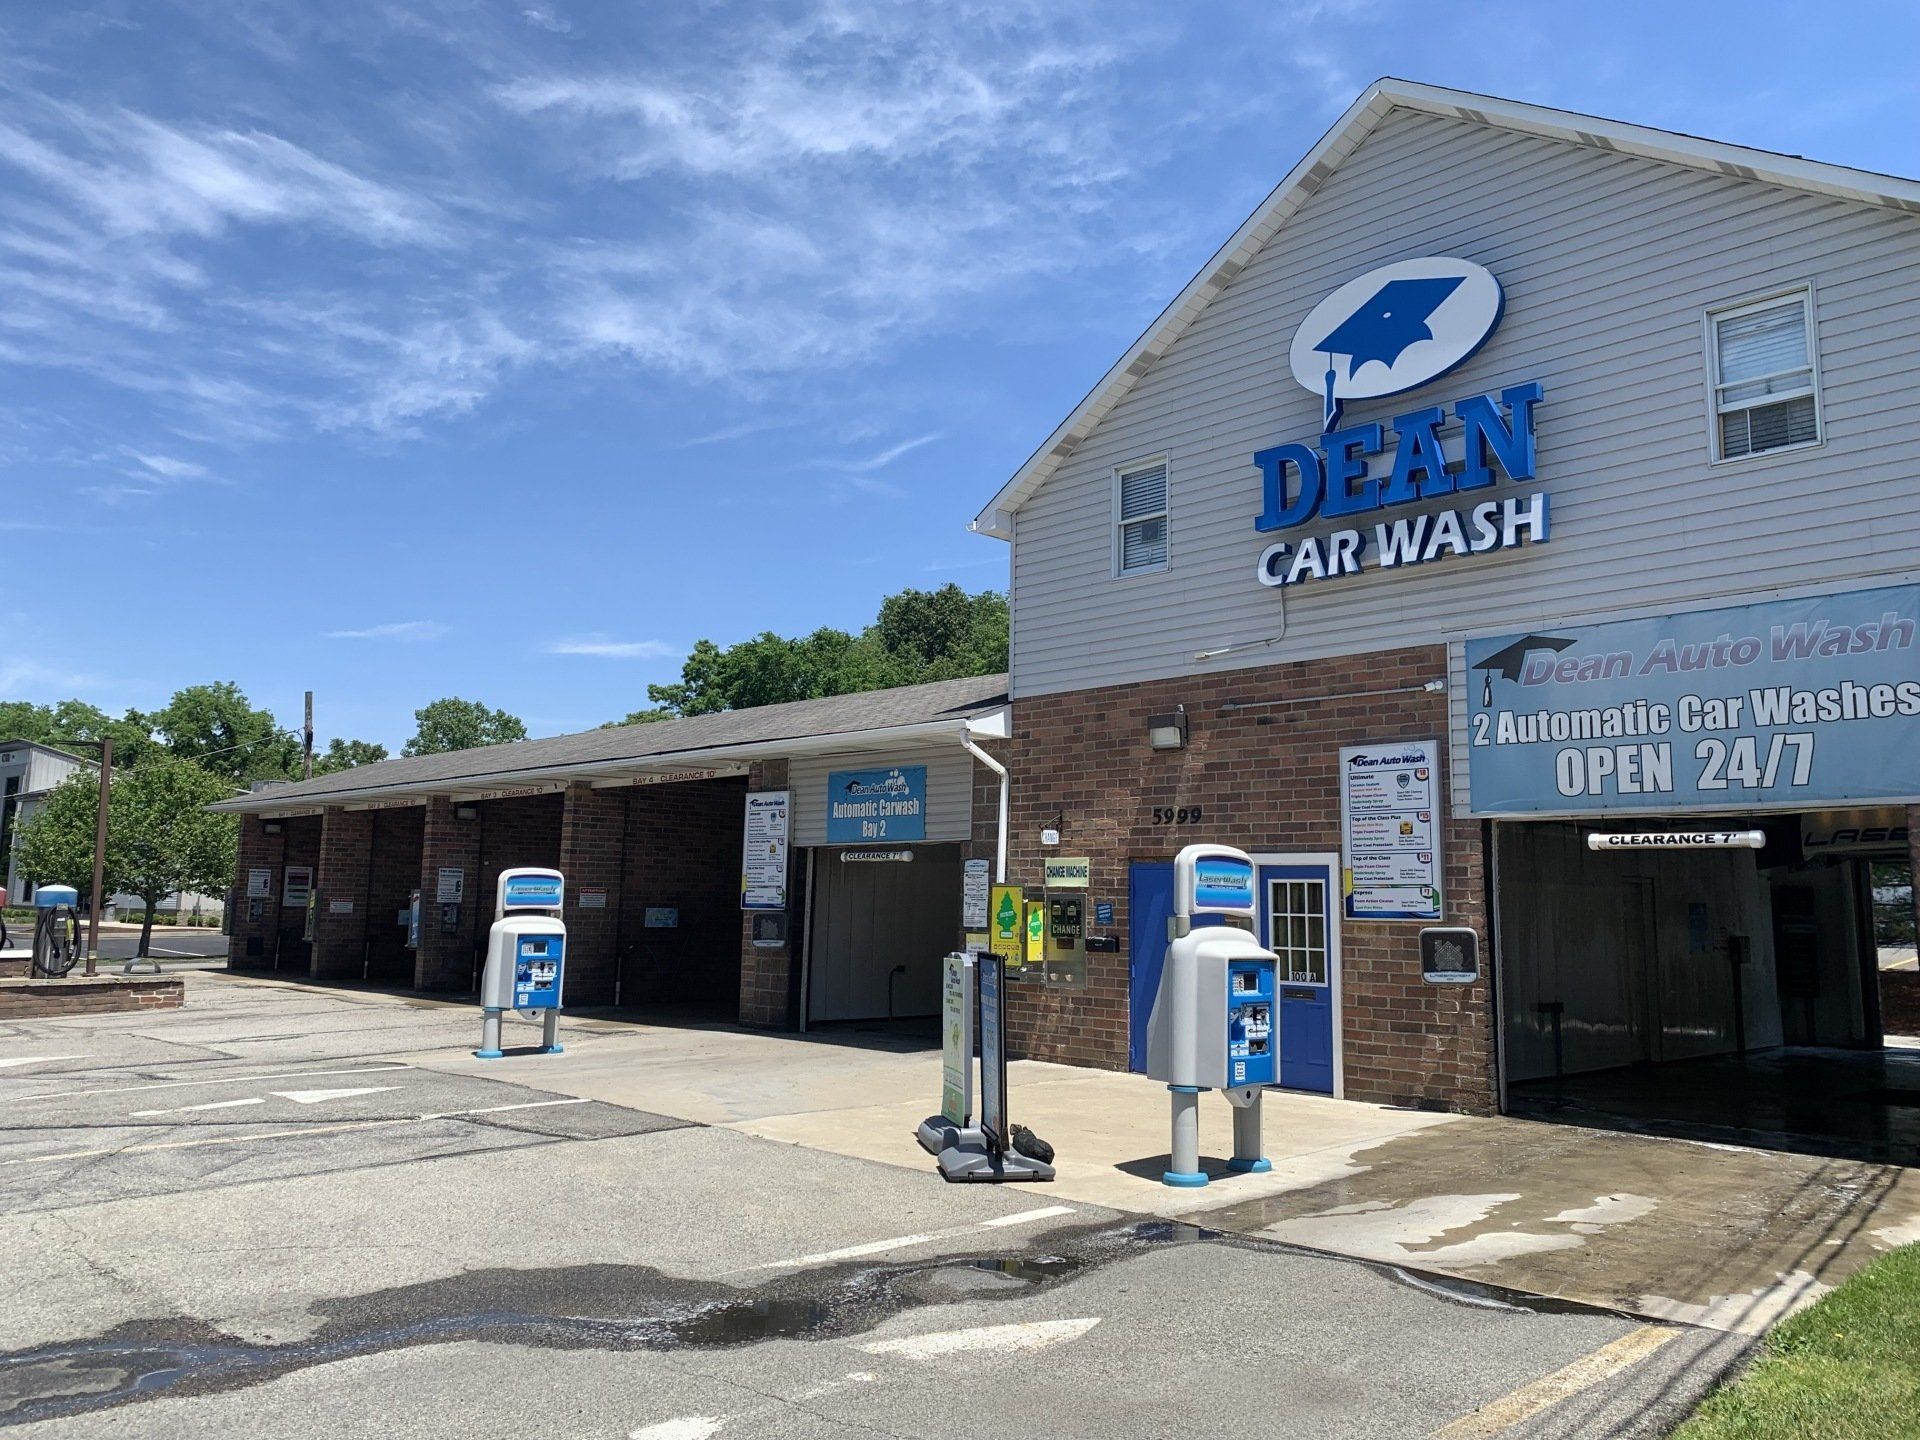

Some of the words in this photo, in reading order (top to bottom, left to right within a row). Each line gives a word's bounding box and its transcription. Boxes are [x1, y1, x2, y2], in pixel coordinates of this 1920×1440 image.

[1254, 382, 1543, 533] DEAN
[1257, 529, 1366, 587] CAR
[1375, 492, 1550, 568] WASH
[1522, 646, 1634, 687] Dean
[1637, 634, 1763, 677] Auto
[1769, 611, 1916, 663] Wash
[1472, 712, 1491, 747] 2
[1496, 699, 1671, 745] Automatic
[1678, 694, 1745, 733] Car
[1749, 680, 1920, 727] Washes
[1357, 759, 1378, 767] Dean
[1380, 757, 1401, 765] Auto
[1402, 755, 1425, 763] Wash
[1555, 741, 1674, 797] OPEN
[1695, 731, 1815, 791] 24/7
[632, 777, 647, 785] BAY
[660, 771, 704, 782] CLEARANCE
[502, 787, 535, 797] CLEARANCE
[851, 783, 869, 795] Dean
[870, 782, 887, 794] Auto
[887, 780, 906, 793] Wash
[384, 800, 408, 808] CLEARANCE
[832, 800, 878, 818] Automatic
[879, 797, 919, 816] Carwash
[1152, 808, 1202, 825] 5999
[862, 820, 878, 838] Bay
[879, 819, 887, 837] 2
[1608, 832, 1716, 847] CLEARANCE
[848, 852, 890, 860] CLEARANCE
[1046, 865, 1065, 878] CHANGE
[1066, 865, 1088, 878] MACHINE
[1199, 872, 1246, 885] LaserWash
[1052, 924, 1081, 935] CHANGE
[1291, 972, 1307, 982] 100
